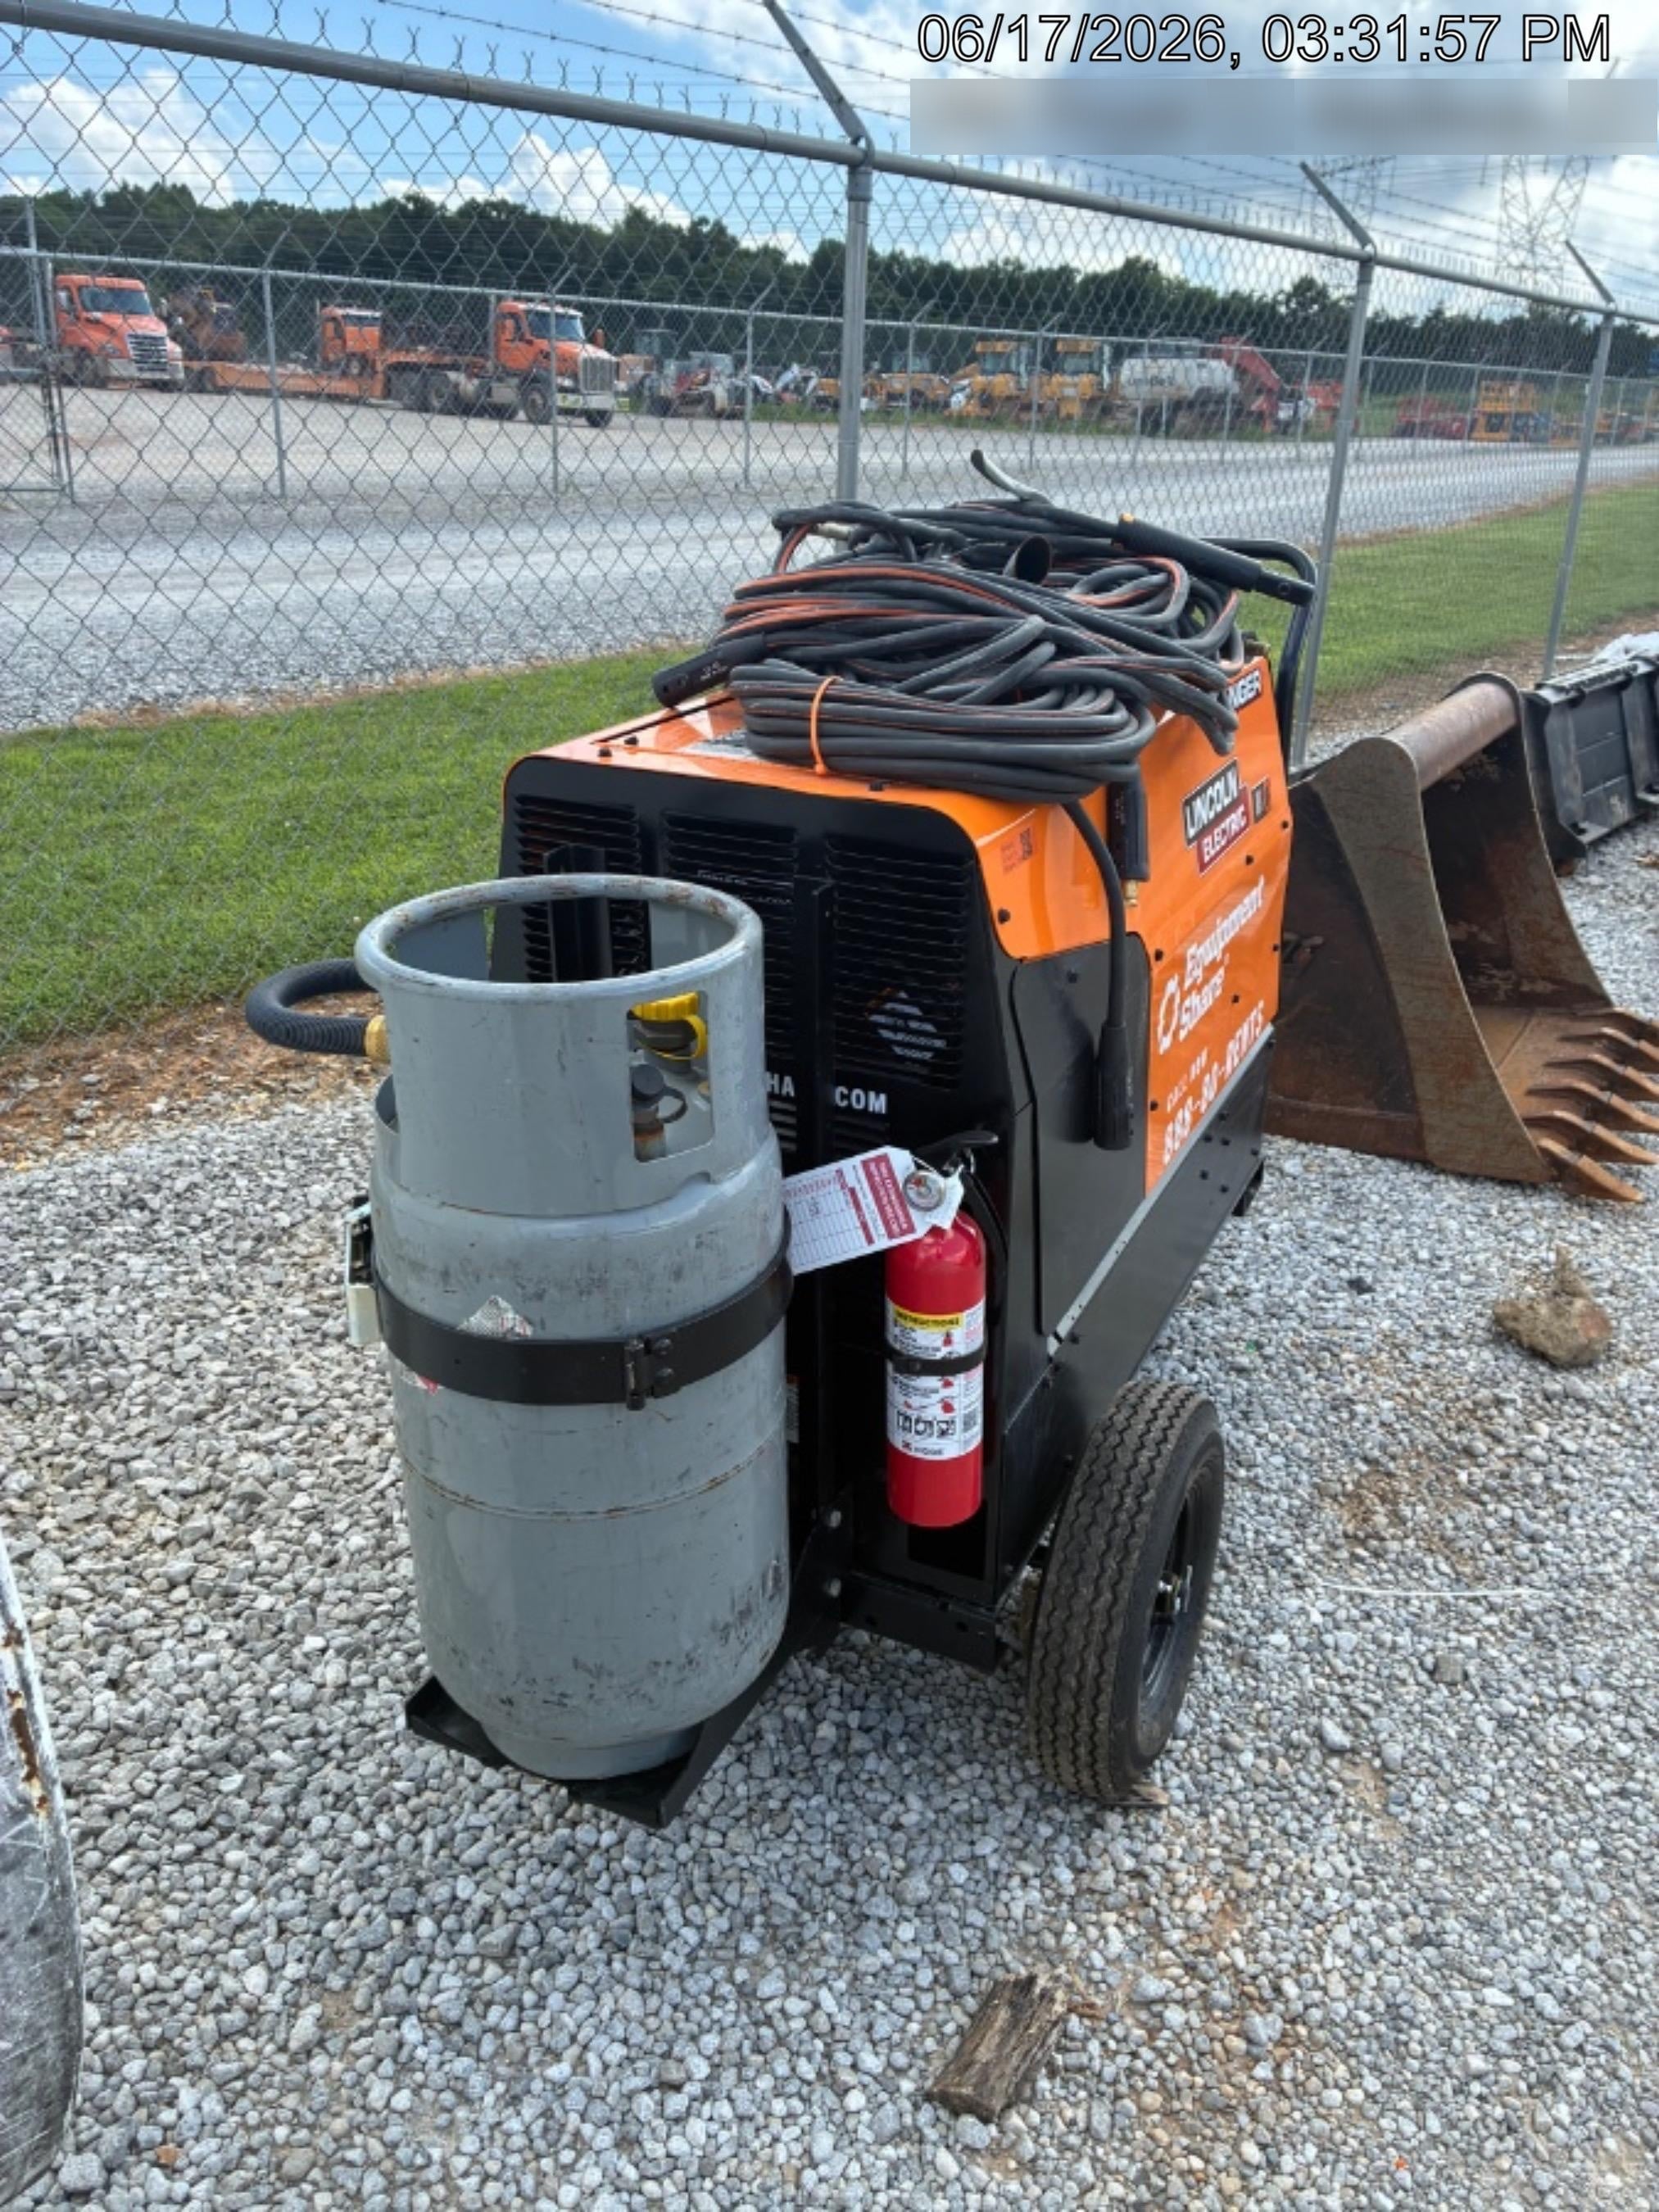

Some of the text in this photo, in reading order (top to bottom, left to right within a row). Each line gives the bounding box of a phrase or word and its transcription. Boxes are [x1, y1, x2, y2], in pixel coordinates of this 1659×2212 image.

[1226, 669, 1262, 710] NGER
[1185, 767, 1238, 839] LINCOLN
[1201, 804, 1247, 863] ELECTRIC
[1179, 969, 1225, 1041] Share
[766, 1072, 796, 1098] HA
